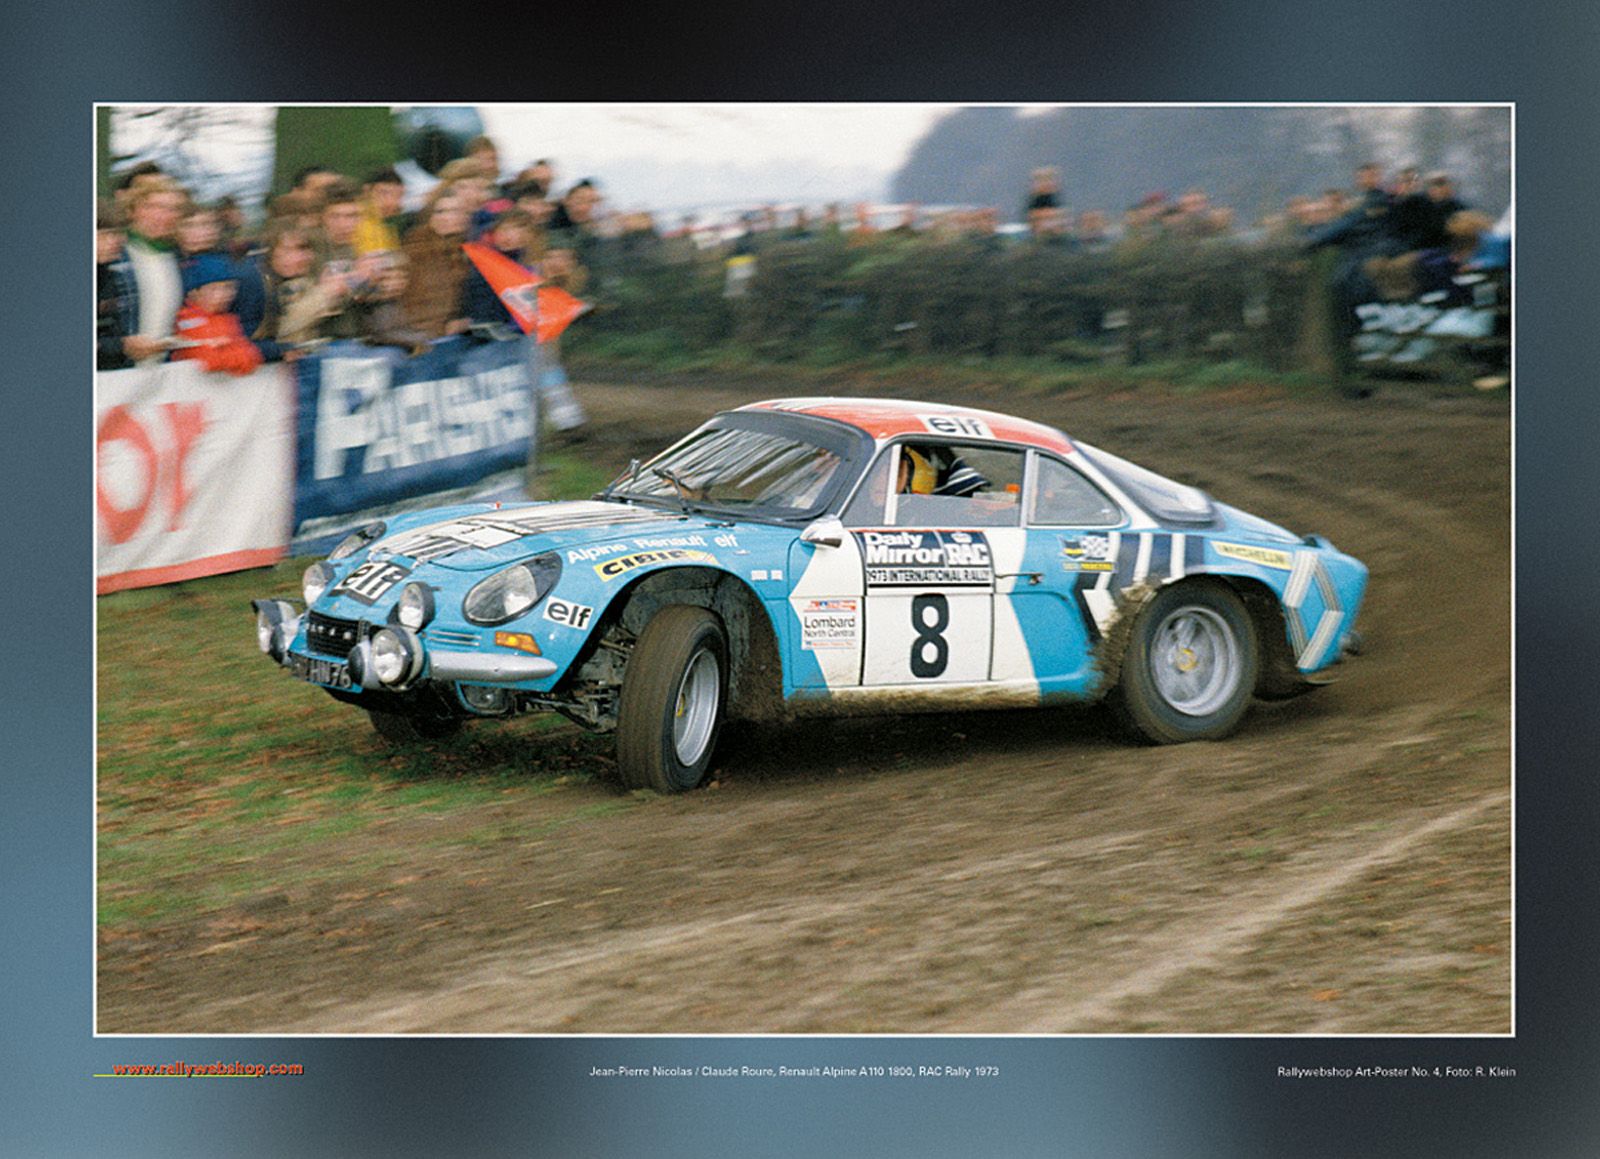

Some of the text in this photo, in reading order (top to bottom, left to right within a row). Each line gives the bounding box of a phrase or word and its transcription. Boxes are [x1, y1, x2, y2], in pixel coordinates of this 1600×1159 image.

[928, 416, 983, 435] elf
[567, 533, 739, 564] Alpine Renault elf
[863, 532, 923, 548] Daily
[866, 543, 990, 564] Mirror RAC
[342, 564, 402, 596] elf
[867, 569, 990, 582] 1973 INTERNATIONAL RALLY
[547, 601, 592, 627] elf
[804, 616, 856, 629] Lombard
[804, 628, 856, 638] North Central
[909, 592, 949, 679] 8
